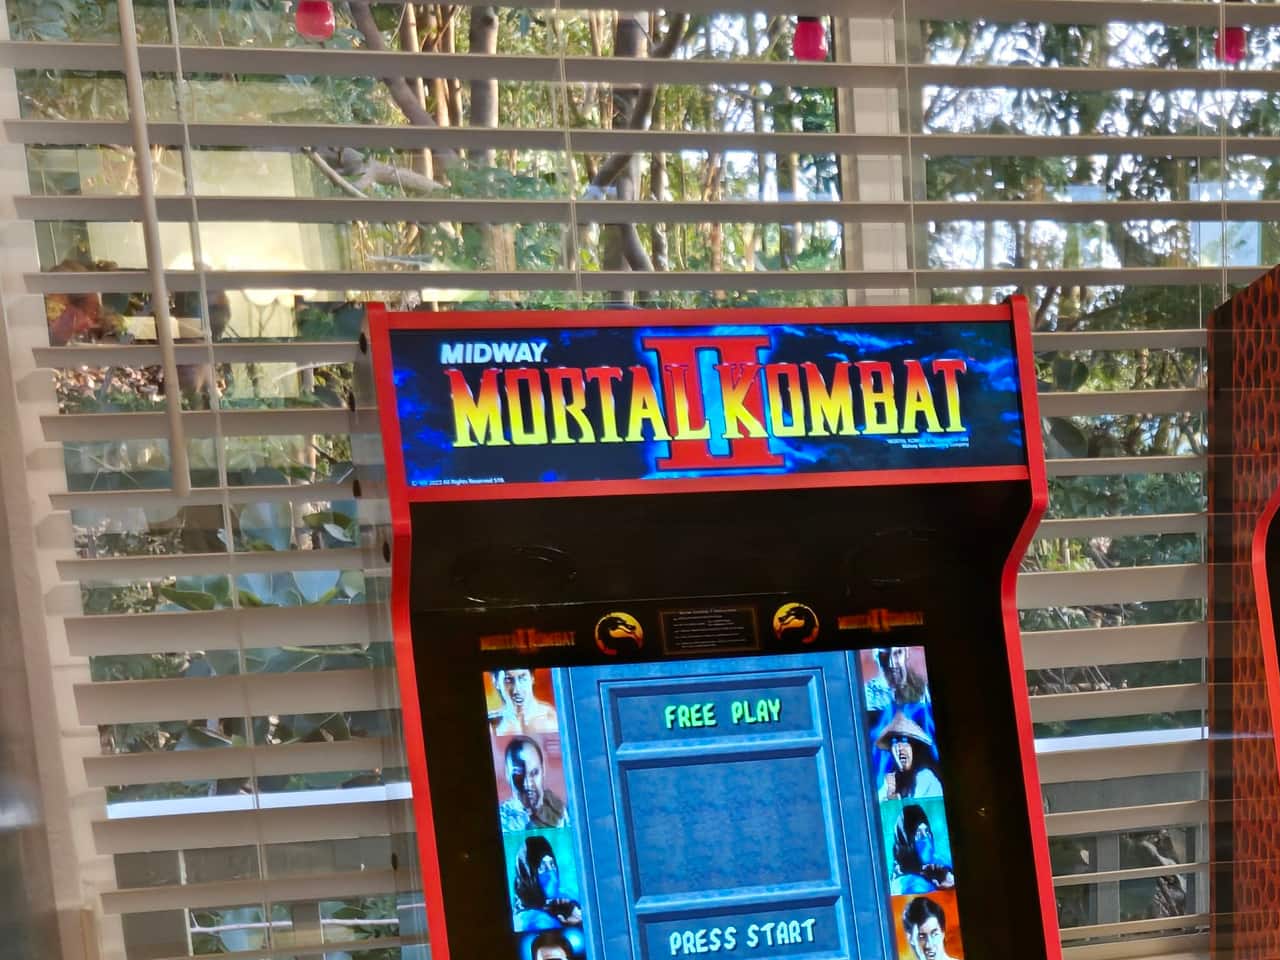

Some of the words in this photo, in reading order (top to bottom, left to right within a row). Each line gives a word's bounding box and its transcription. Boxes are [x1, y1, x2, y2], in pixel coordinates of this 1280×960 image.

[440, 342, 547, 364] MIDWAY
[445, 362, 711, 449] MORTAL
[714, 357, 968, 440] KOMBAT
[665, 702, 717, 730] FREE
[731, 698, 782, 726] PLAY
[669, 926, 738, 956] PRESS
[747, 917, 817, 949] START
